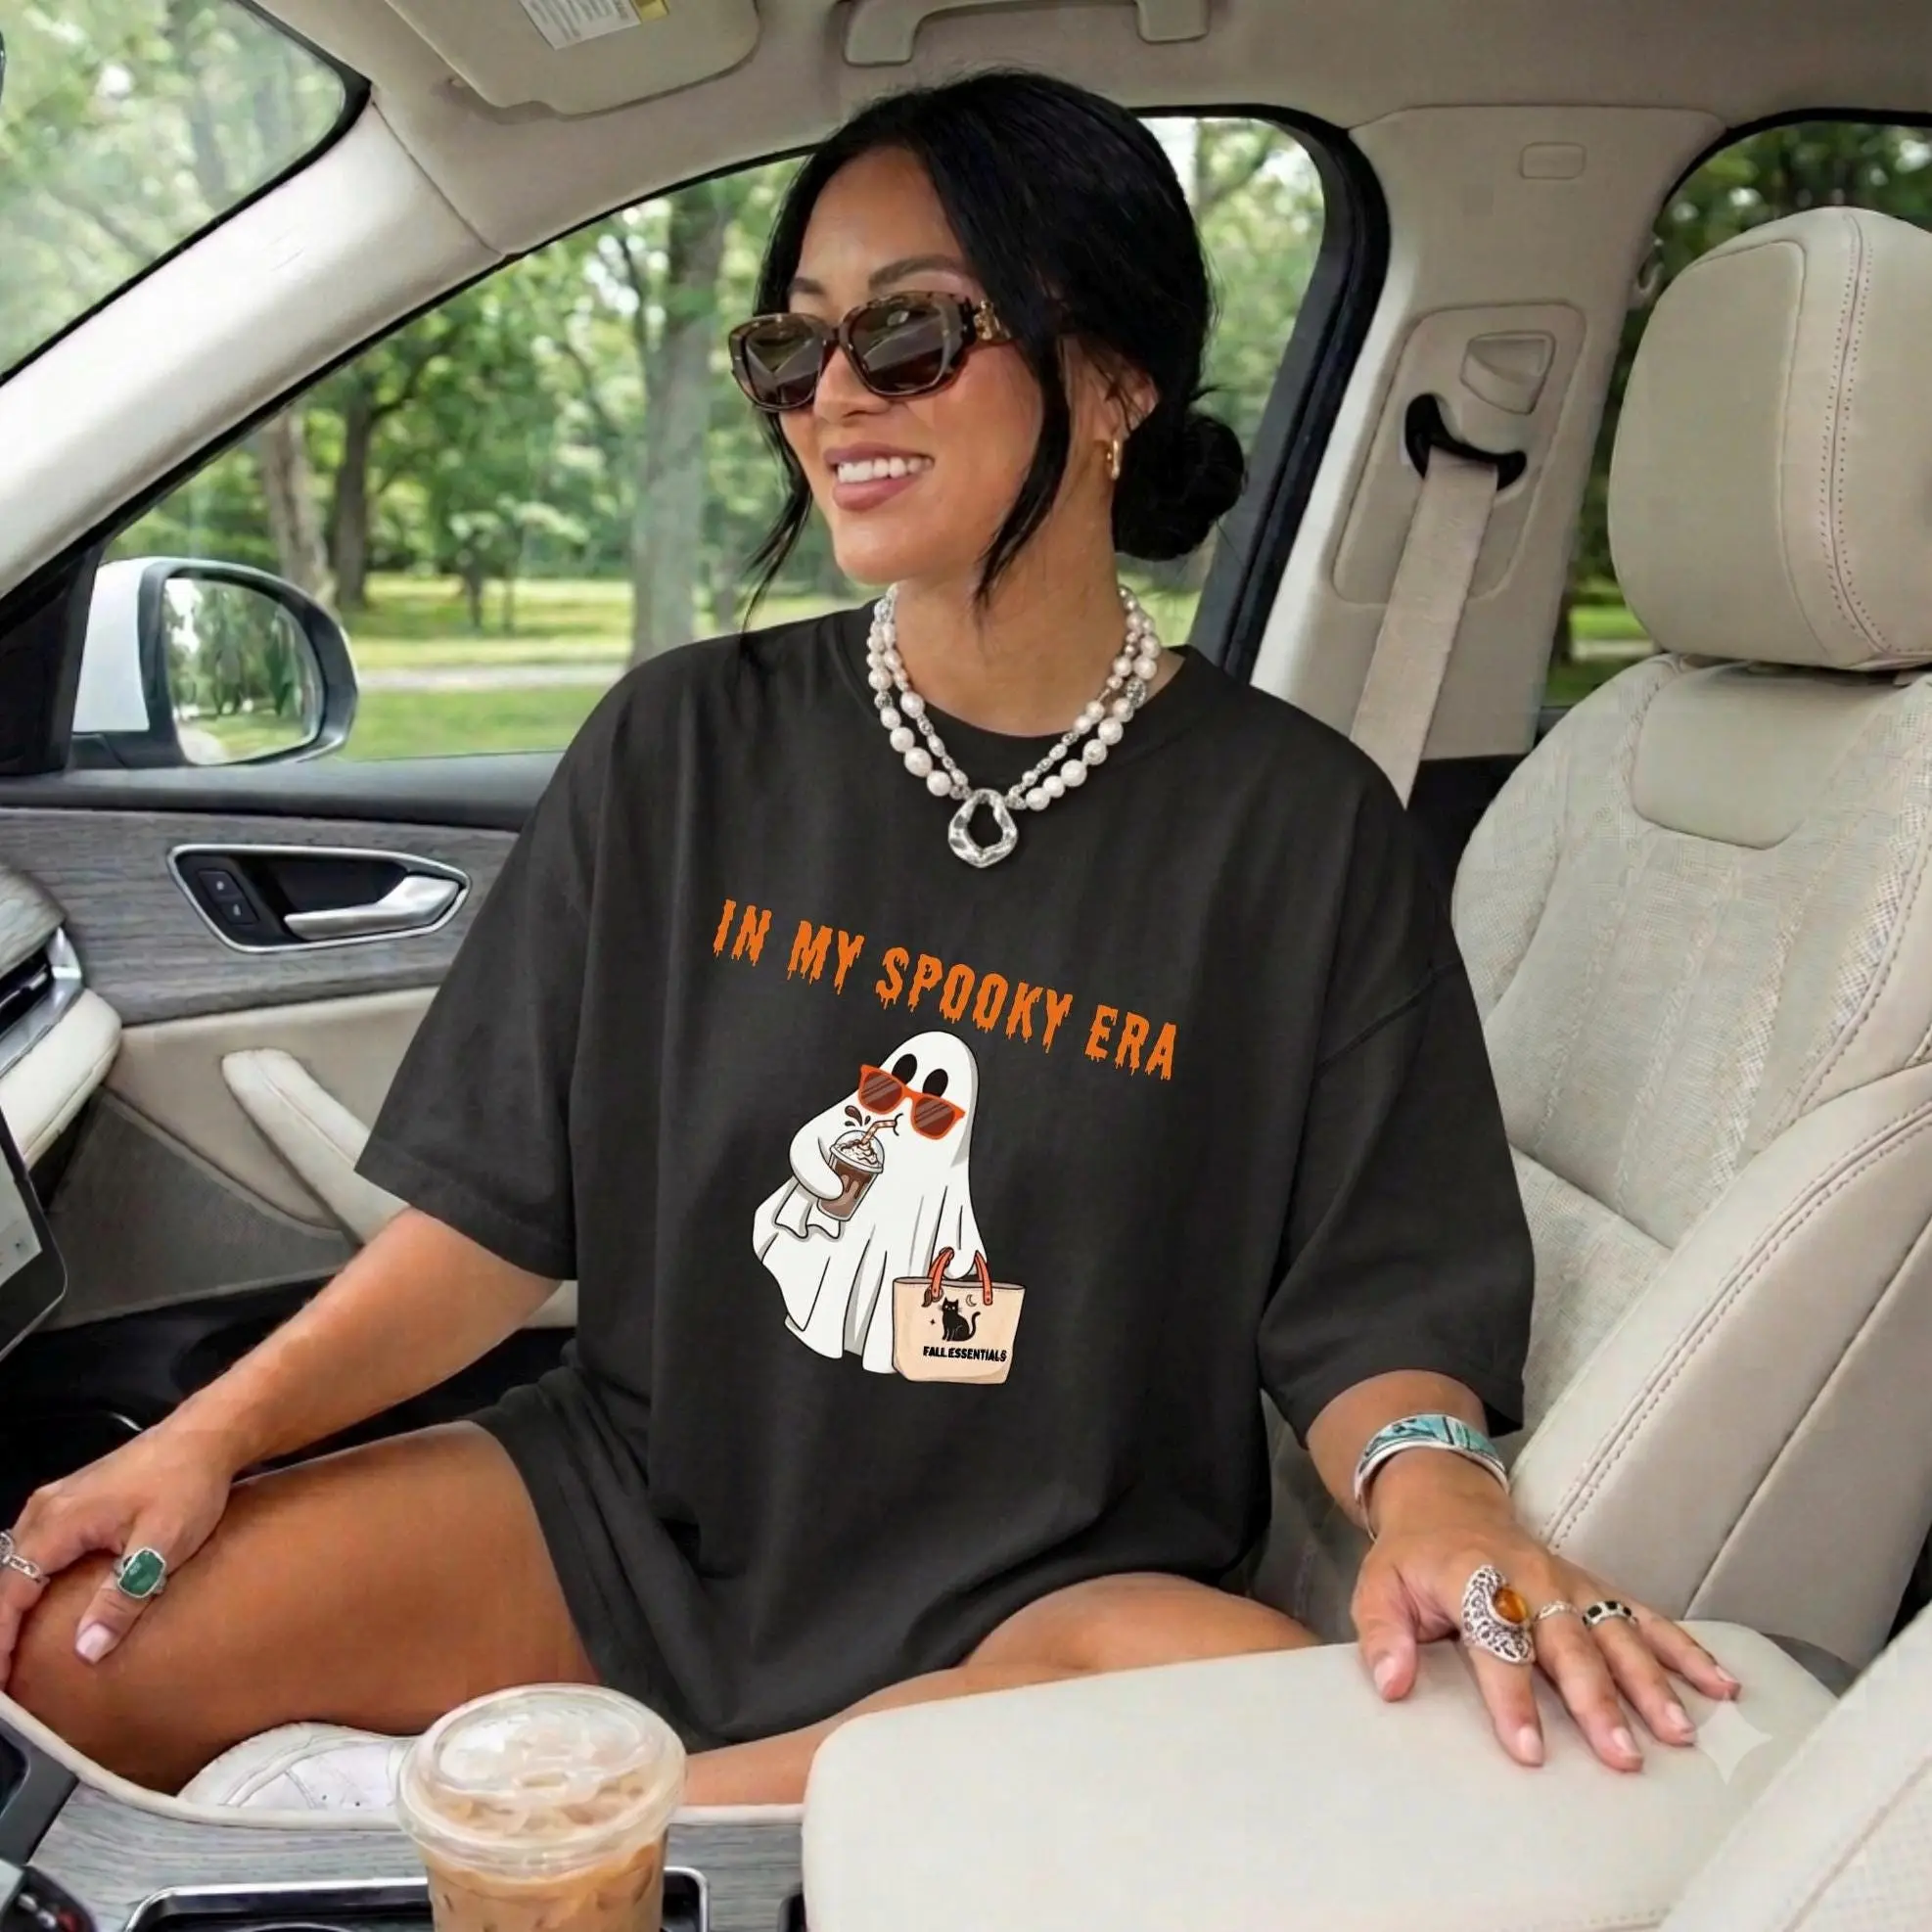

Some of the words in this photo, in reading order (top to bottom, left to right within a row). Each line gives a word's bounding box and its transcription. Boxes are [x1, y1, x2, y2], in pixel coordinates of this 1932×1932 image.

[713, 899, 771, 965] IN
[788, 920, 864, 993] MY
[876, 946, 1073, 1052] SPOOKY
[1084, 1004, 1176, 1080] ERA
[923, 1346, 947, 1357] FALL
[947, 1347, 1007, 1361] ESSENTIALS
